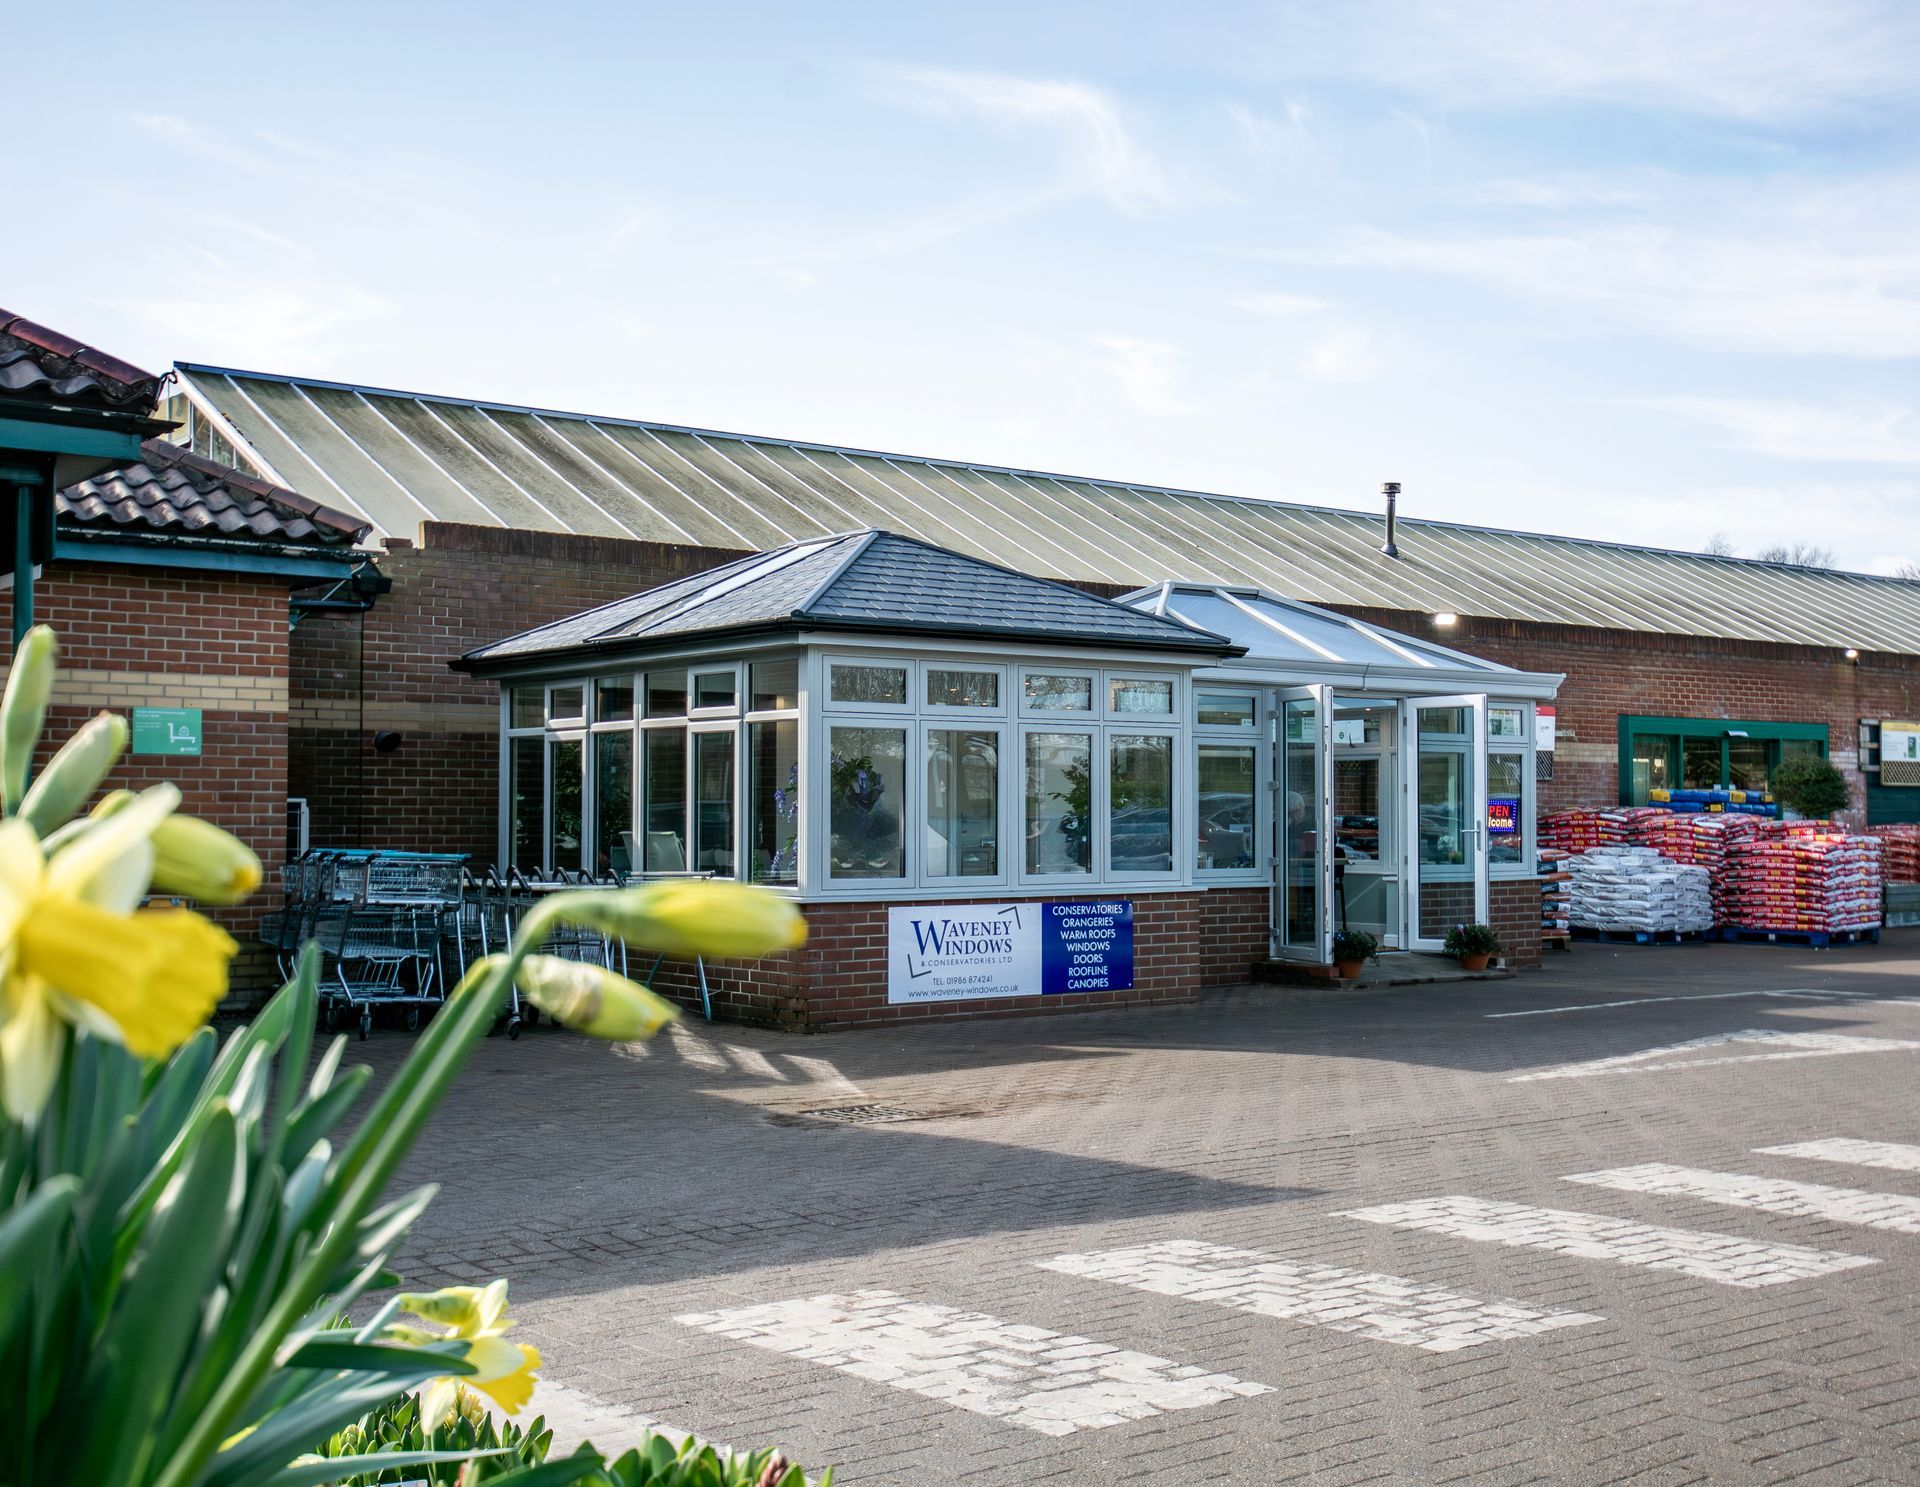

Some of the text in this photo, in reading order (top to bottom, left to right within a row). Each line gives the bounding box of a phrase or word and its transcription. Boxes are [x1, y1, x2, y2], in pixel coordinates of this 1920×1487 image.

[1488, 805, 1509, 817] PEN
[1488, 816, 1513, 828] lcome
[1052, 904, 1123, 916] CONSERVATORIES
[1062, 916, 1114, 928] ORANGERIES
[1060, 928, 1116, 940] WARM ROOFS
[1066, 940, 1110, 952] WINDOWS
[928, 957, 996, 967] CONSERVATORIES
[999, 956, 1013, 964] LTD
[1073, 953, 1103, 964] DOORS
[1068, 965, 1108, 977] ROOFLINE
[946, 976, 967, 985] 01986
[968, 975, 993, 984] 874241
[1067, 977, 1109, 989] CANOPIES
[908, 984, 1019, 998] www.waveney-windows.co.uk
